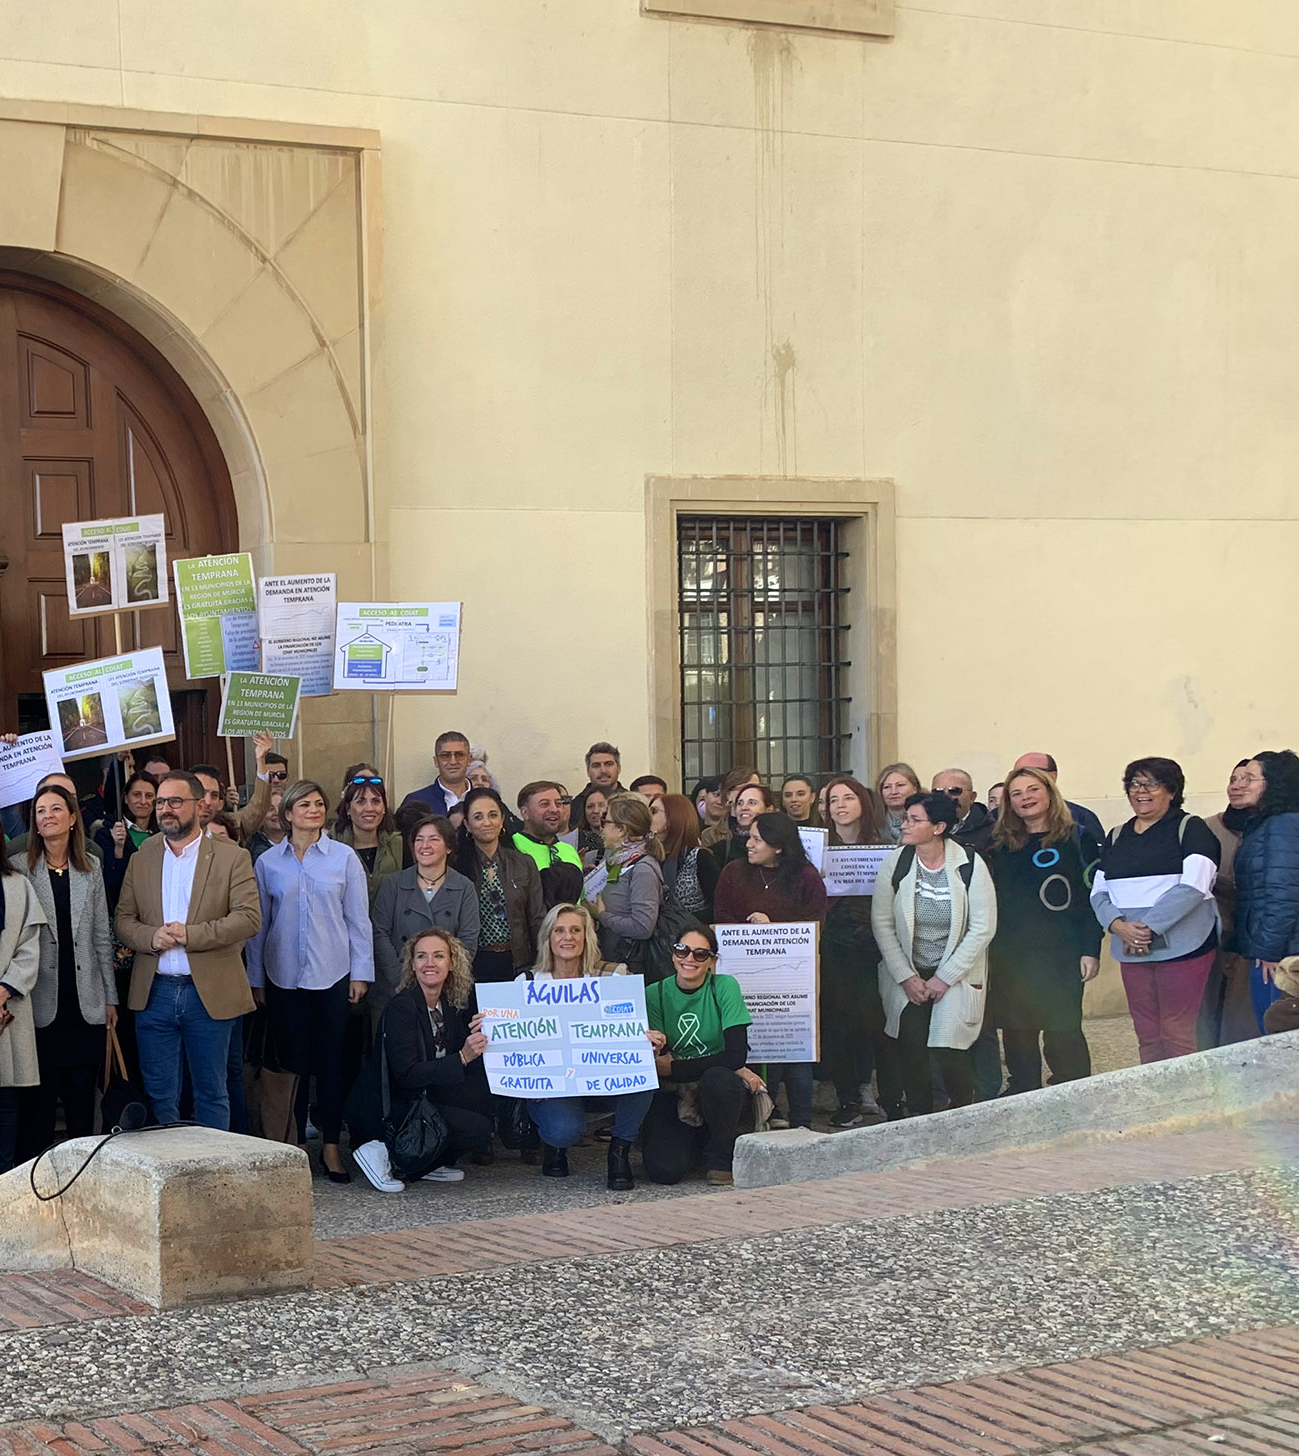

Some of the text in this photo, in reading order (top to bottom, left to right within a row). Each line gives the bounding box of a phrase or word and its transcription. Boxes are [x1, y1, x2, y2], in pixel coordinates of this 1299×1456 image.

[192, 569, 239, 581] TEMPRANA
[199, 581, 234, 590] MUNICIPIOS
[287, 578, 315, 586] AUMENTO
[265, 588, 294, 596] DEMANDA
[304, 585, 330, 593] ATENCIÓN
[191, 600, 222, 608] GRATUITA
[362, 608, 387, 616] ACCESO
[390, 608, 397, 616] AL
[68, 671, 92, 680] ACCESO
[51, 680, 98, 694] ATENCIÓN TEMPRANA
[241, 688, 285, 699] TEMPRANA
[244, 701, 277, 709] MUNICIPIOS
[232, 718, 261, 726] GRATUITA
[22, 742, 53, 755] ATENCIÓN
[2, 756, 37, 771] TEMPRANA
[721, 929, 740, 937] ANTE
[751, 928, 789, 936] AUMENTO
[801, 927, 810, 935] LA
[722, 936, 809, 947] DEMANDA EN ATENCIÓN
[746, 948, 787, 956] TEMPRANA
[527, 980, 601, 1005] ÁGUILAS
[483, 1008, 519, 1019] POR UNA
[491, 1018, 646, 1041] ATENCIÓN TEMPRANA
[503, 1051, 643, 1067] PÚBLICA UNIVERSAL
[500, 1075, 647, 1092] GRATUITA DE CALIDAD
